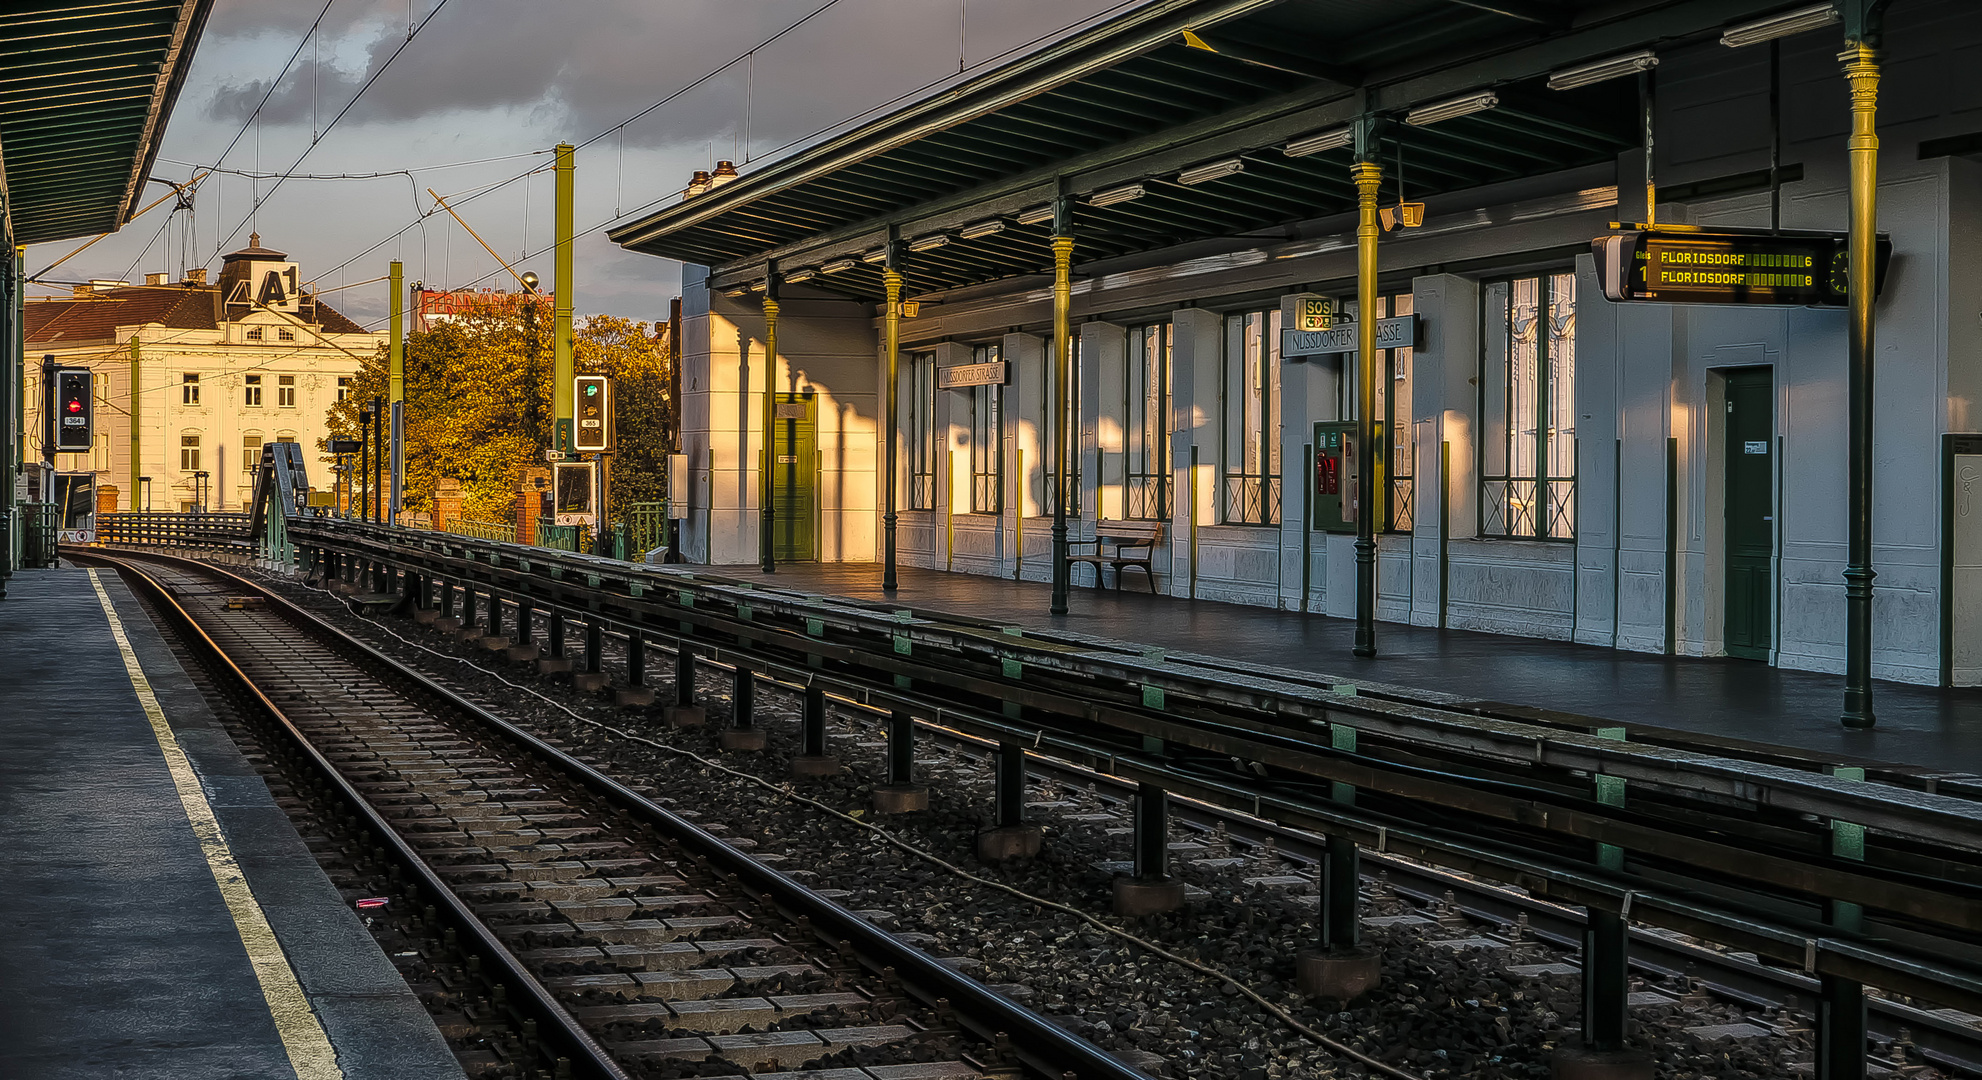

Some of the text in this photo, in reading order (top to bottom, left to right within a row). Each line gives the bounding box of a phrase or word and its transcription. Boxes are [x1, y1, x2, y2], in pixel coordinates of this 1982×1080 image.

[1660, 251, 1812, 267] FLORIDSDORF 6
[1639, 265, 1647, 282] 1
[1660, 271, 1812, 286] FLORIDSDORF 8
[256, 265, 297, 309] A1
[1306, 300, 1331, 315] SOS
[1292, 328, 1354, 351] NUSSDORFER
